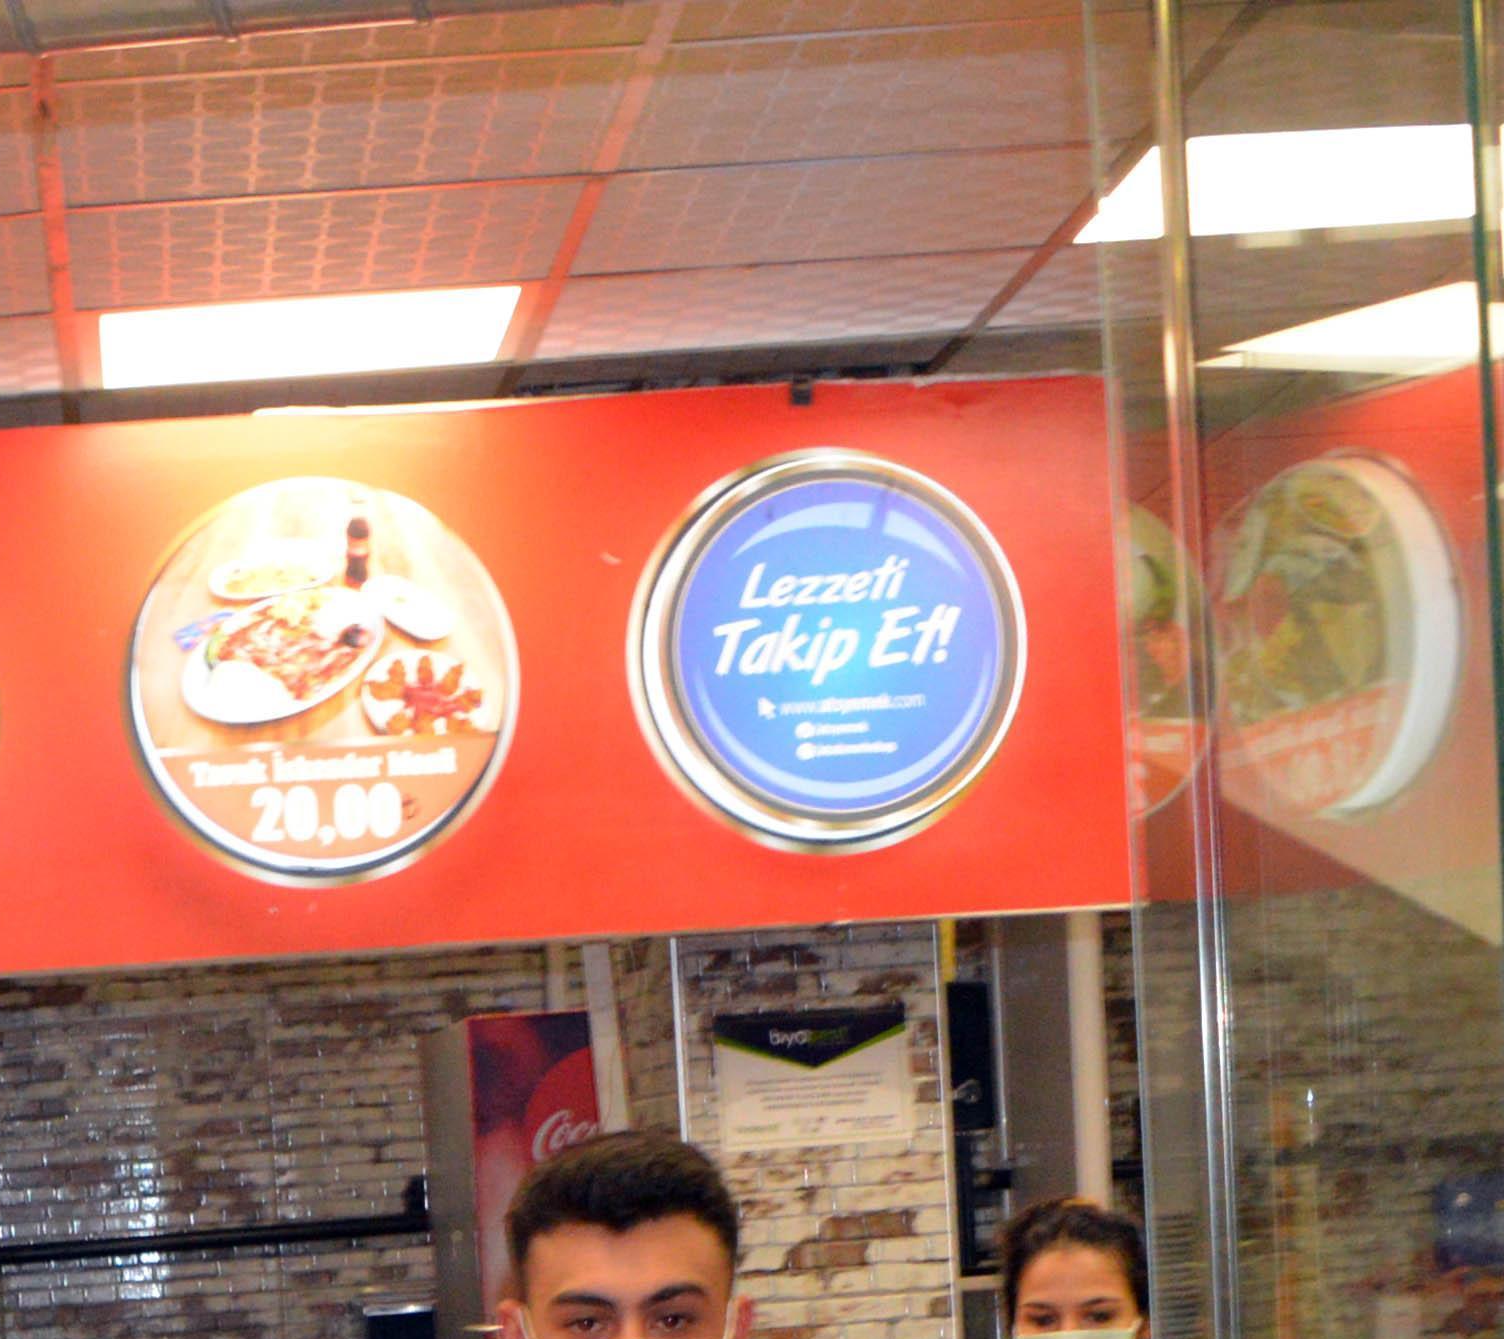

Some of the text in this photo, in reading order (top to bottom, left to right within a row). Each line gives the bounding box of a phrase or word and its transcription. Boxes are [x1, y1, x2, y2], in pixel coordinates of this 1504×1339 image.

[739, 554, 911, 609] Lezzeti
[713, 604, 962, 687] Takip Et!
